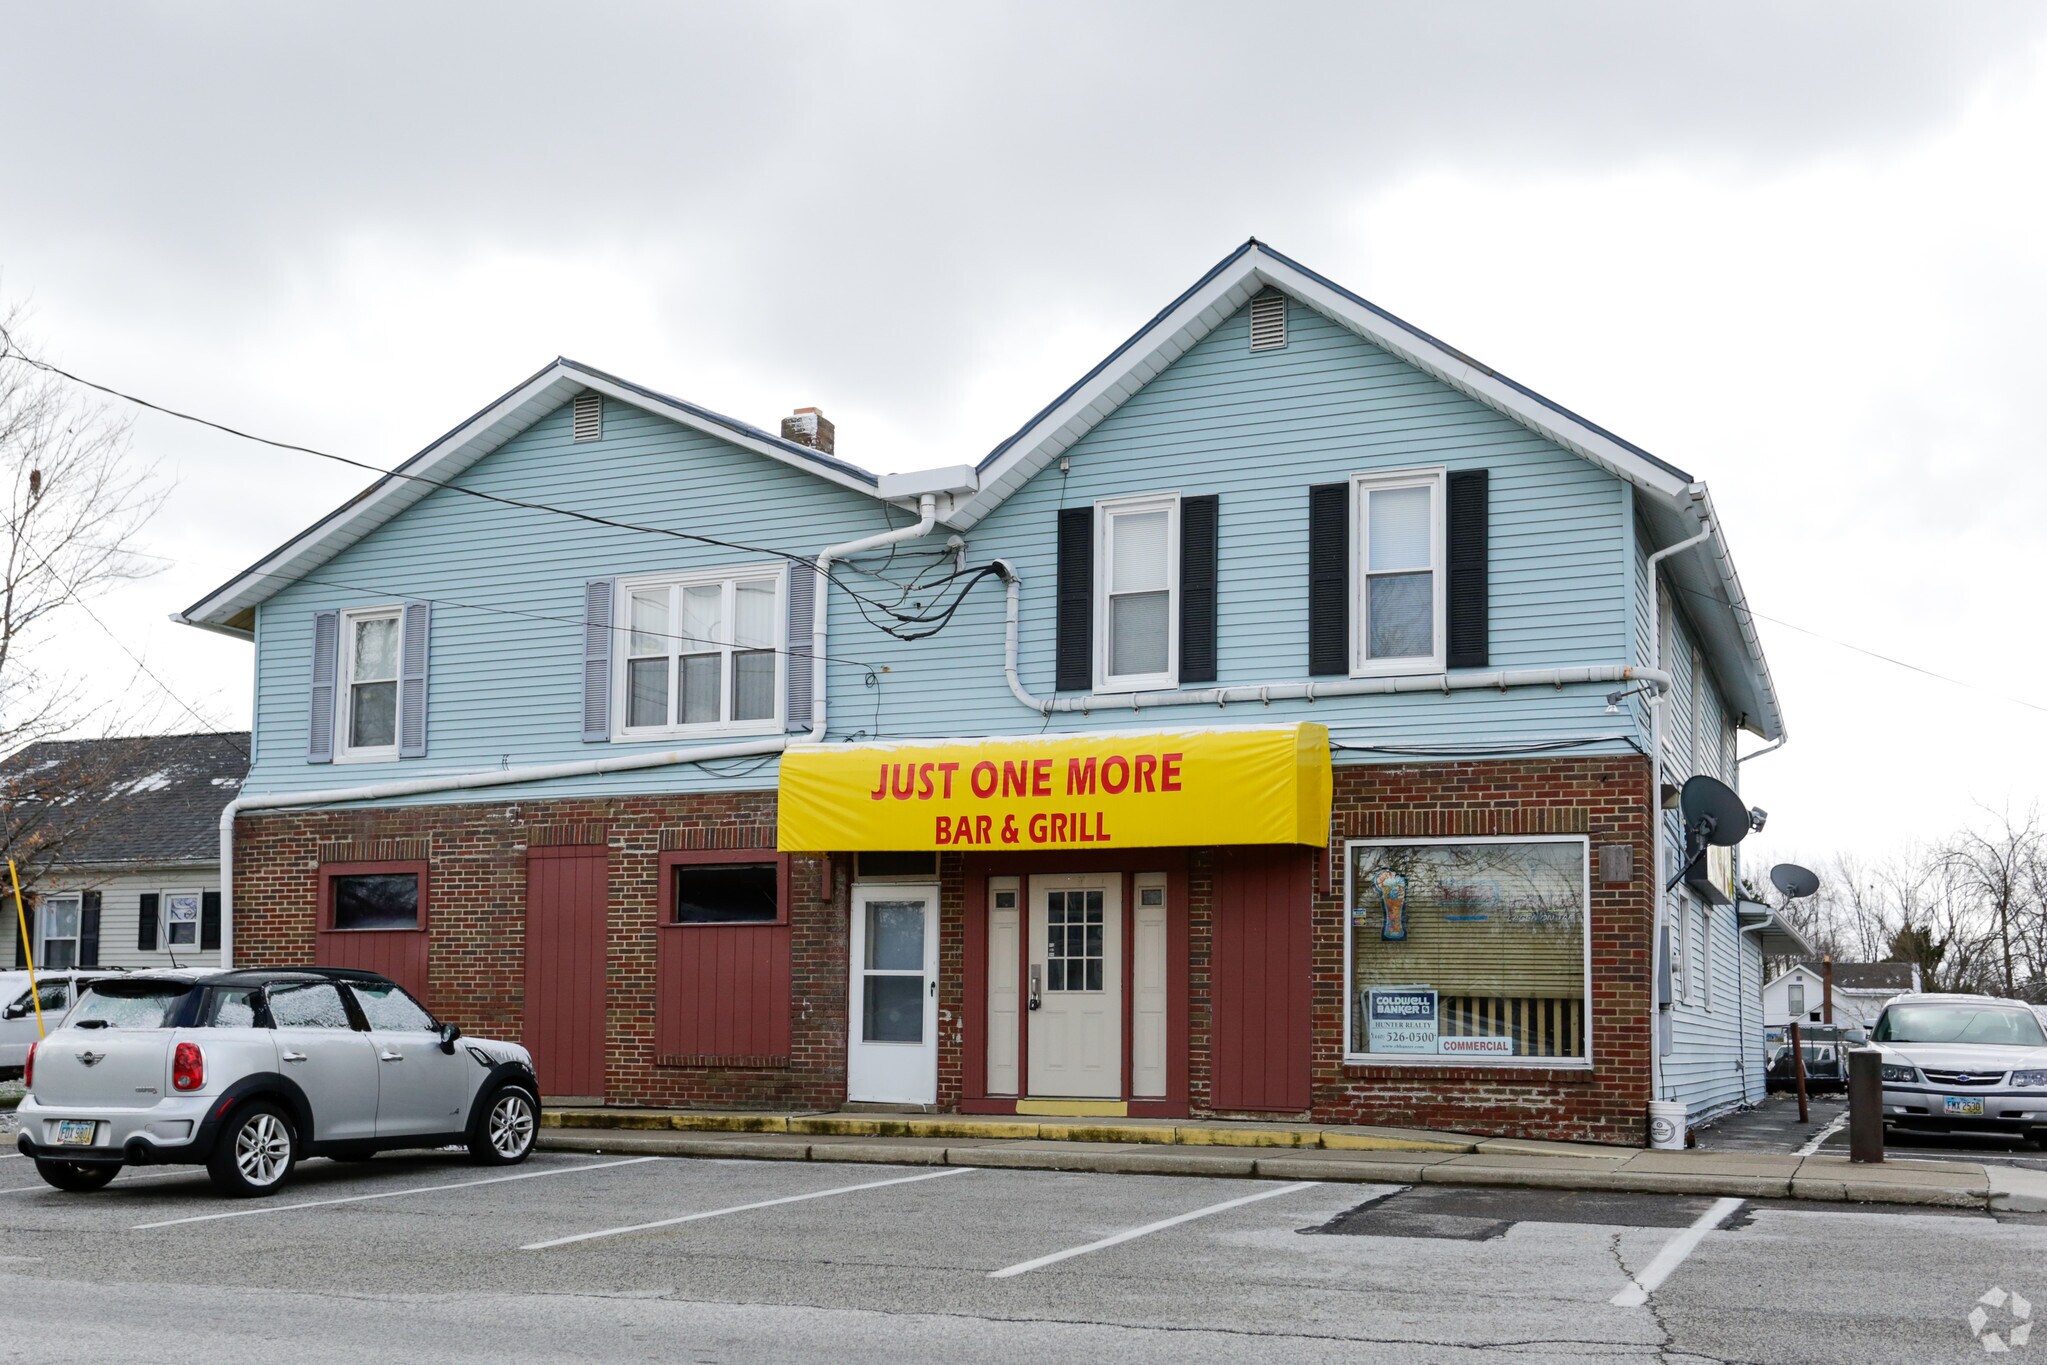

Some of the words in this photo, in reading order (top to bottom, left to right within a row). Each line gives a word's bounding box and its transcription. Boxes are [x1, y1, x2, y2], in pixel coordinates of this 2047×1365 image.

[871, 762, 959, 800] JUST
[971, 759, 1052, 798] ONE
[1066, 753, 1183, 796] MORE
[935, 815, 992, 845] BAR
[1001, 814, 1020, 844] &
[1028, 811, 1111, 844] GRILL
[1386, 1031, 1434, 1042] 526-0500
[1443, 1041, 1509, 1051] COMMERCIAL
